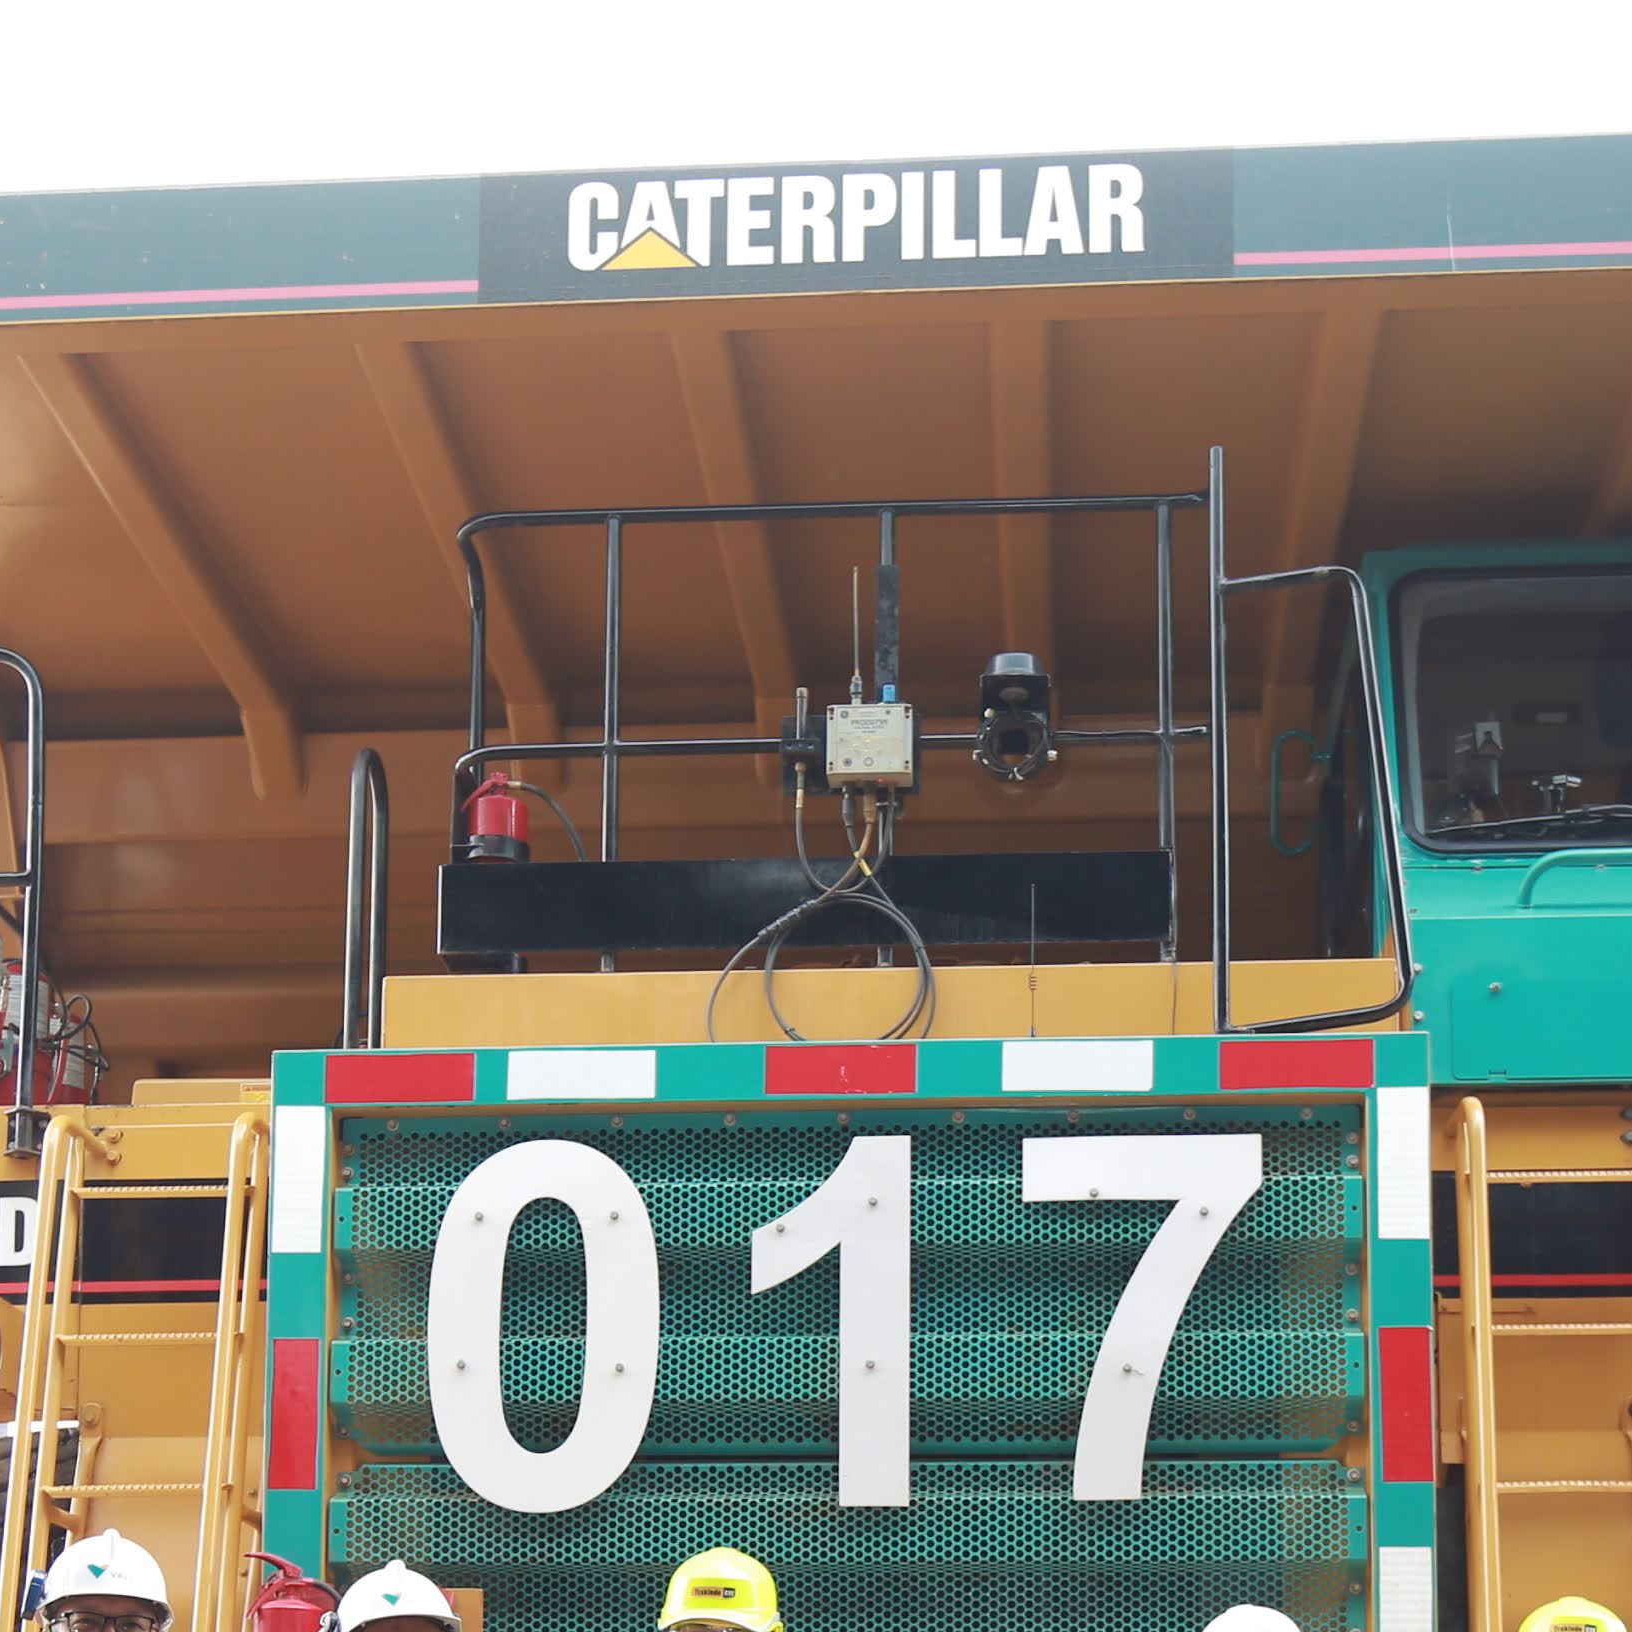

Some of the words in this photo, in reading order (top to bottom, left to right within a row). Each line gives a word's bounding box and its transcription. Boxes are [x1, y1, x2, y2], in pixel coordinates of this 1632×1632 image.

[567, 163, 1145, 271] CATERPILLAR
[427, 1133, 1263, 1513] 017
[694, 1588, 721, 1597] Trakindo
